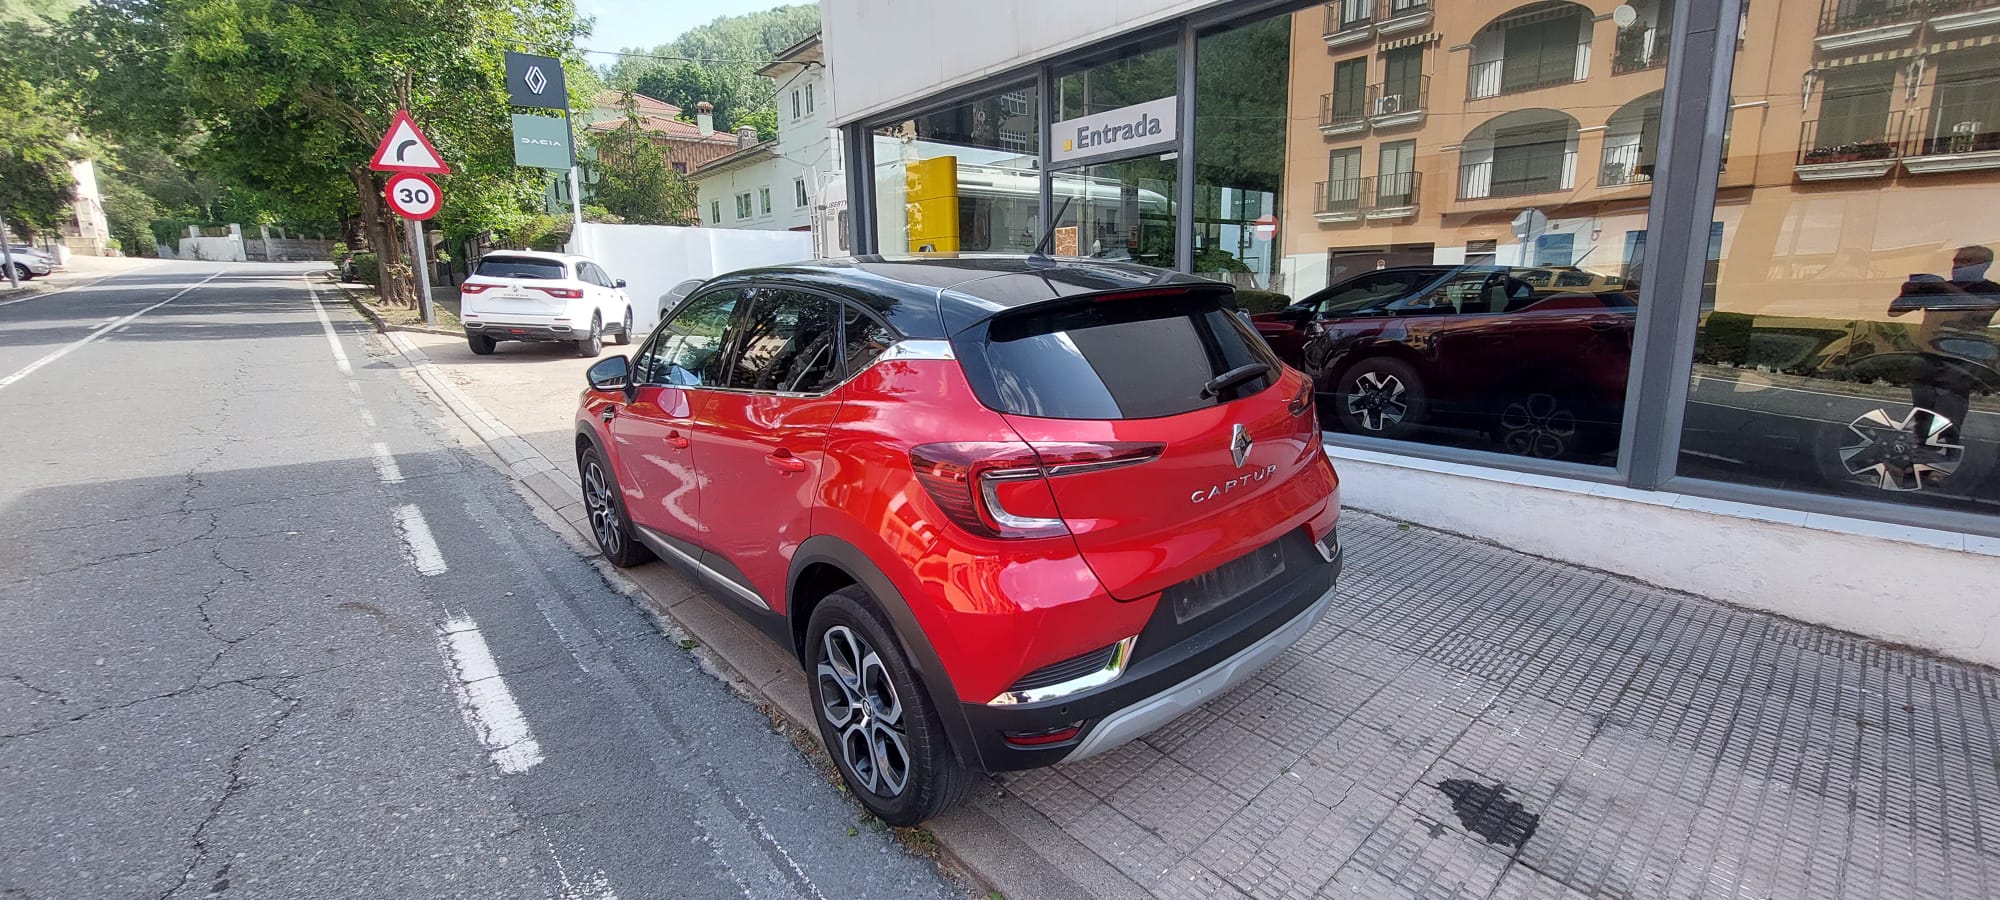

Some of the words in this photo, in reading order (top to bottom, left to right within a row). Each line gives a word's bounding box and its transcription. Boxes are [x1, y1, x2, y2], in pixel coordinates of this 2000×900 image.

[521, 137, 561, 146] DACIA
[1077, 113, 1162, 149] Entrada
[399, 188, 429, 204] 30
[1191, 464, 1277, 503] CAPTUR
